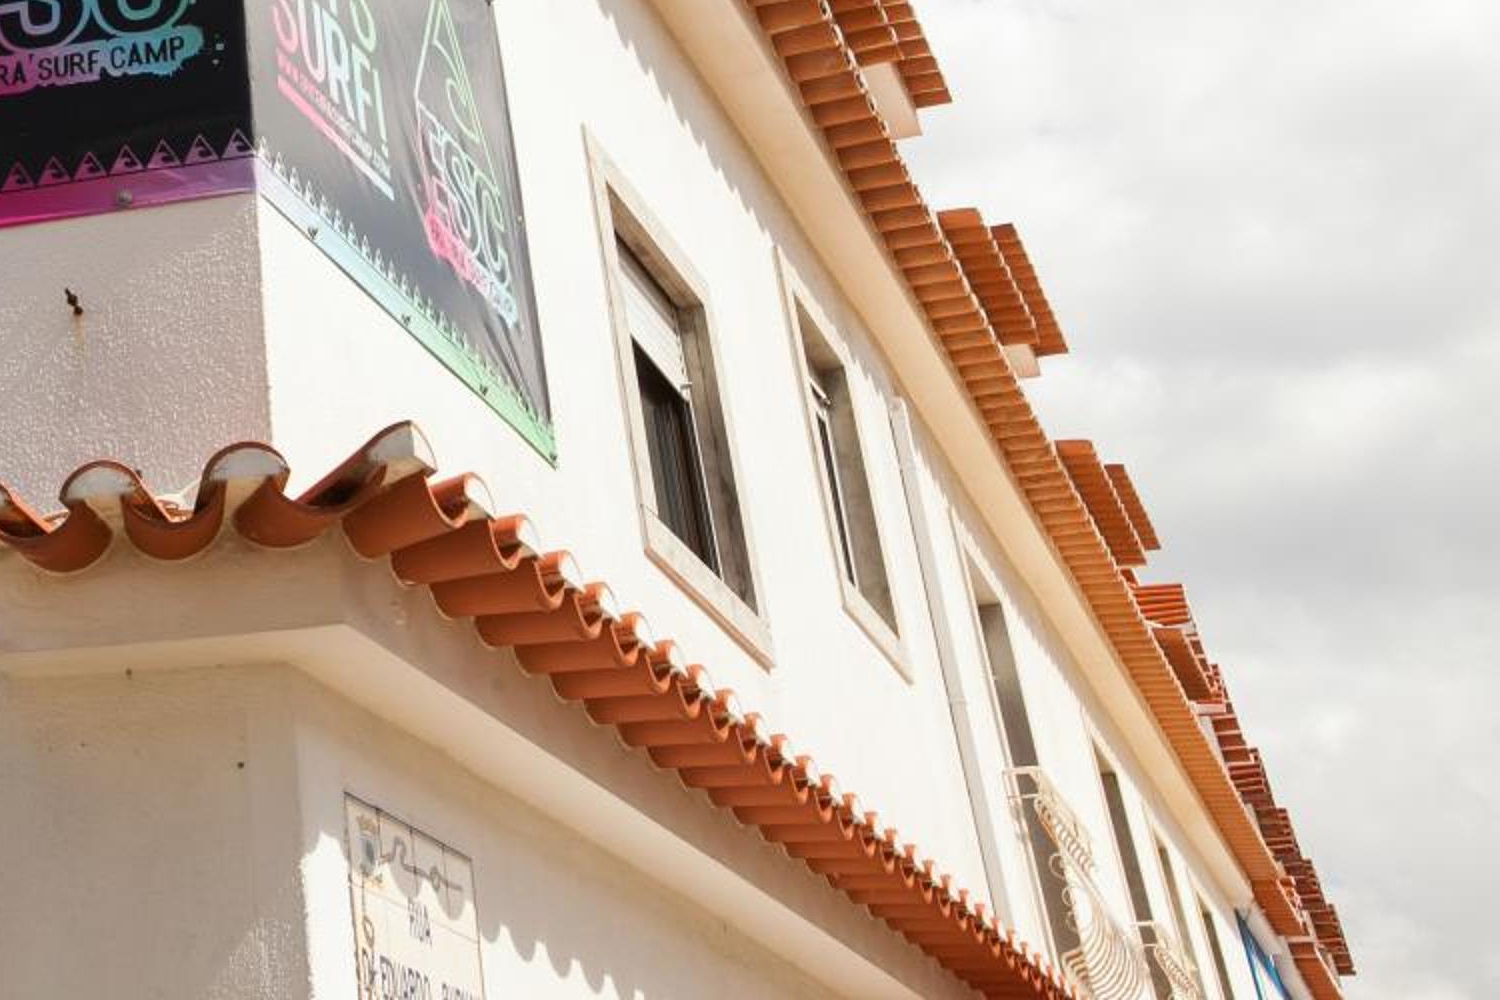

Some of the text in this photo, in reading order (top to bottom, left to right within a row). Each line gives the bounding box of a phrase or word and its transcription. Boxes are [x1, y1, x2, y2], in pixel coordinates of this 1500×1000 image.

[38, 49, 98, 81] SURF
[110, 36, 185, 70] CAMP
[416, 103, 511, 290] ESC
